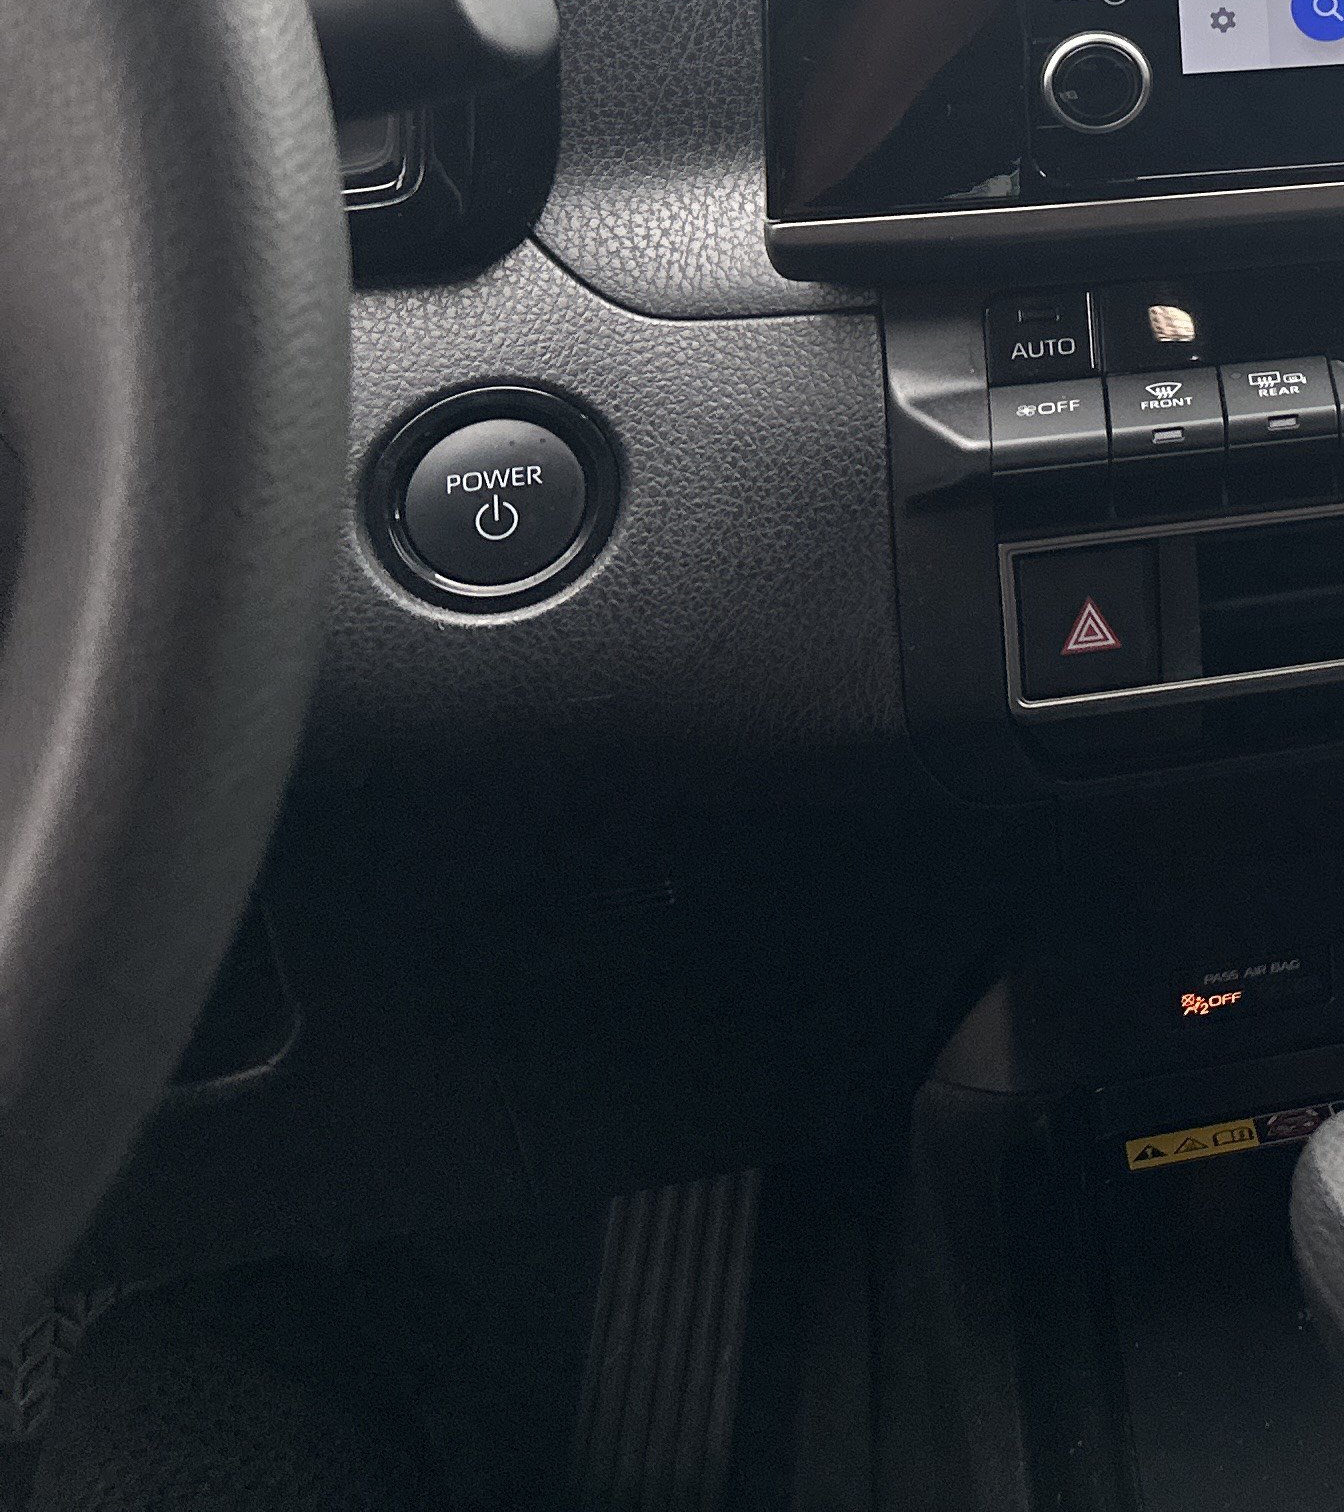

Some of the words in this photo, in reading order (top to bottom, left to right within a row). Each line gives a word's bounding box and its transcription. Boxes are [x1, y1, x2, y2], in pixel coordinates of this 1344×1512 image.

[1010, 336, 1076, 361] AUTO
[1258, 386, 1300, 398] REAR
[1037, 399, 1081, 415] OFF
[1140, 396, 1193, 410] FRONT
[446, 465, 543, 494] POWER
[1204, 970, 1239, 985] PASS
[1243, 963, 1268, 978] AIR
[1208, 991, 1242, 1007] OFF
